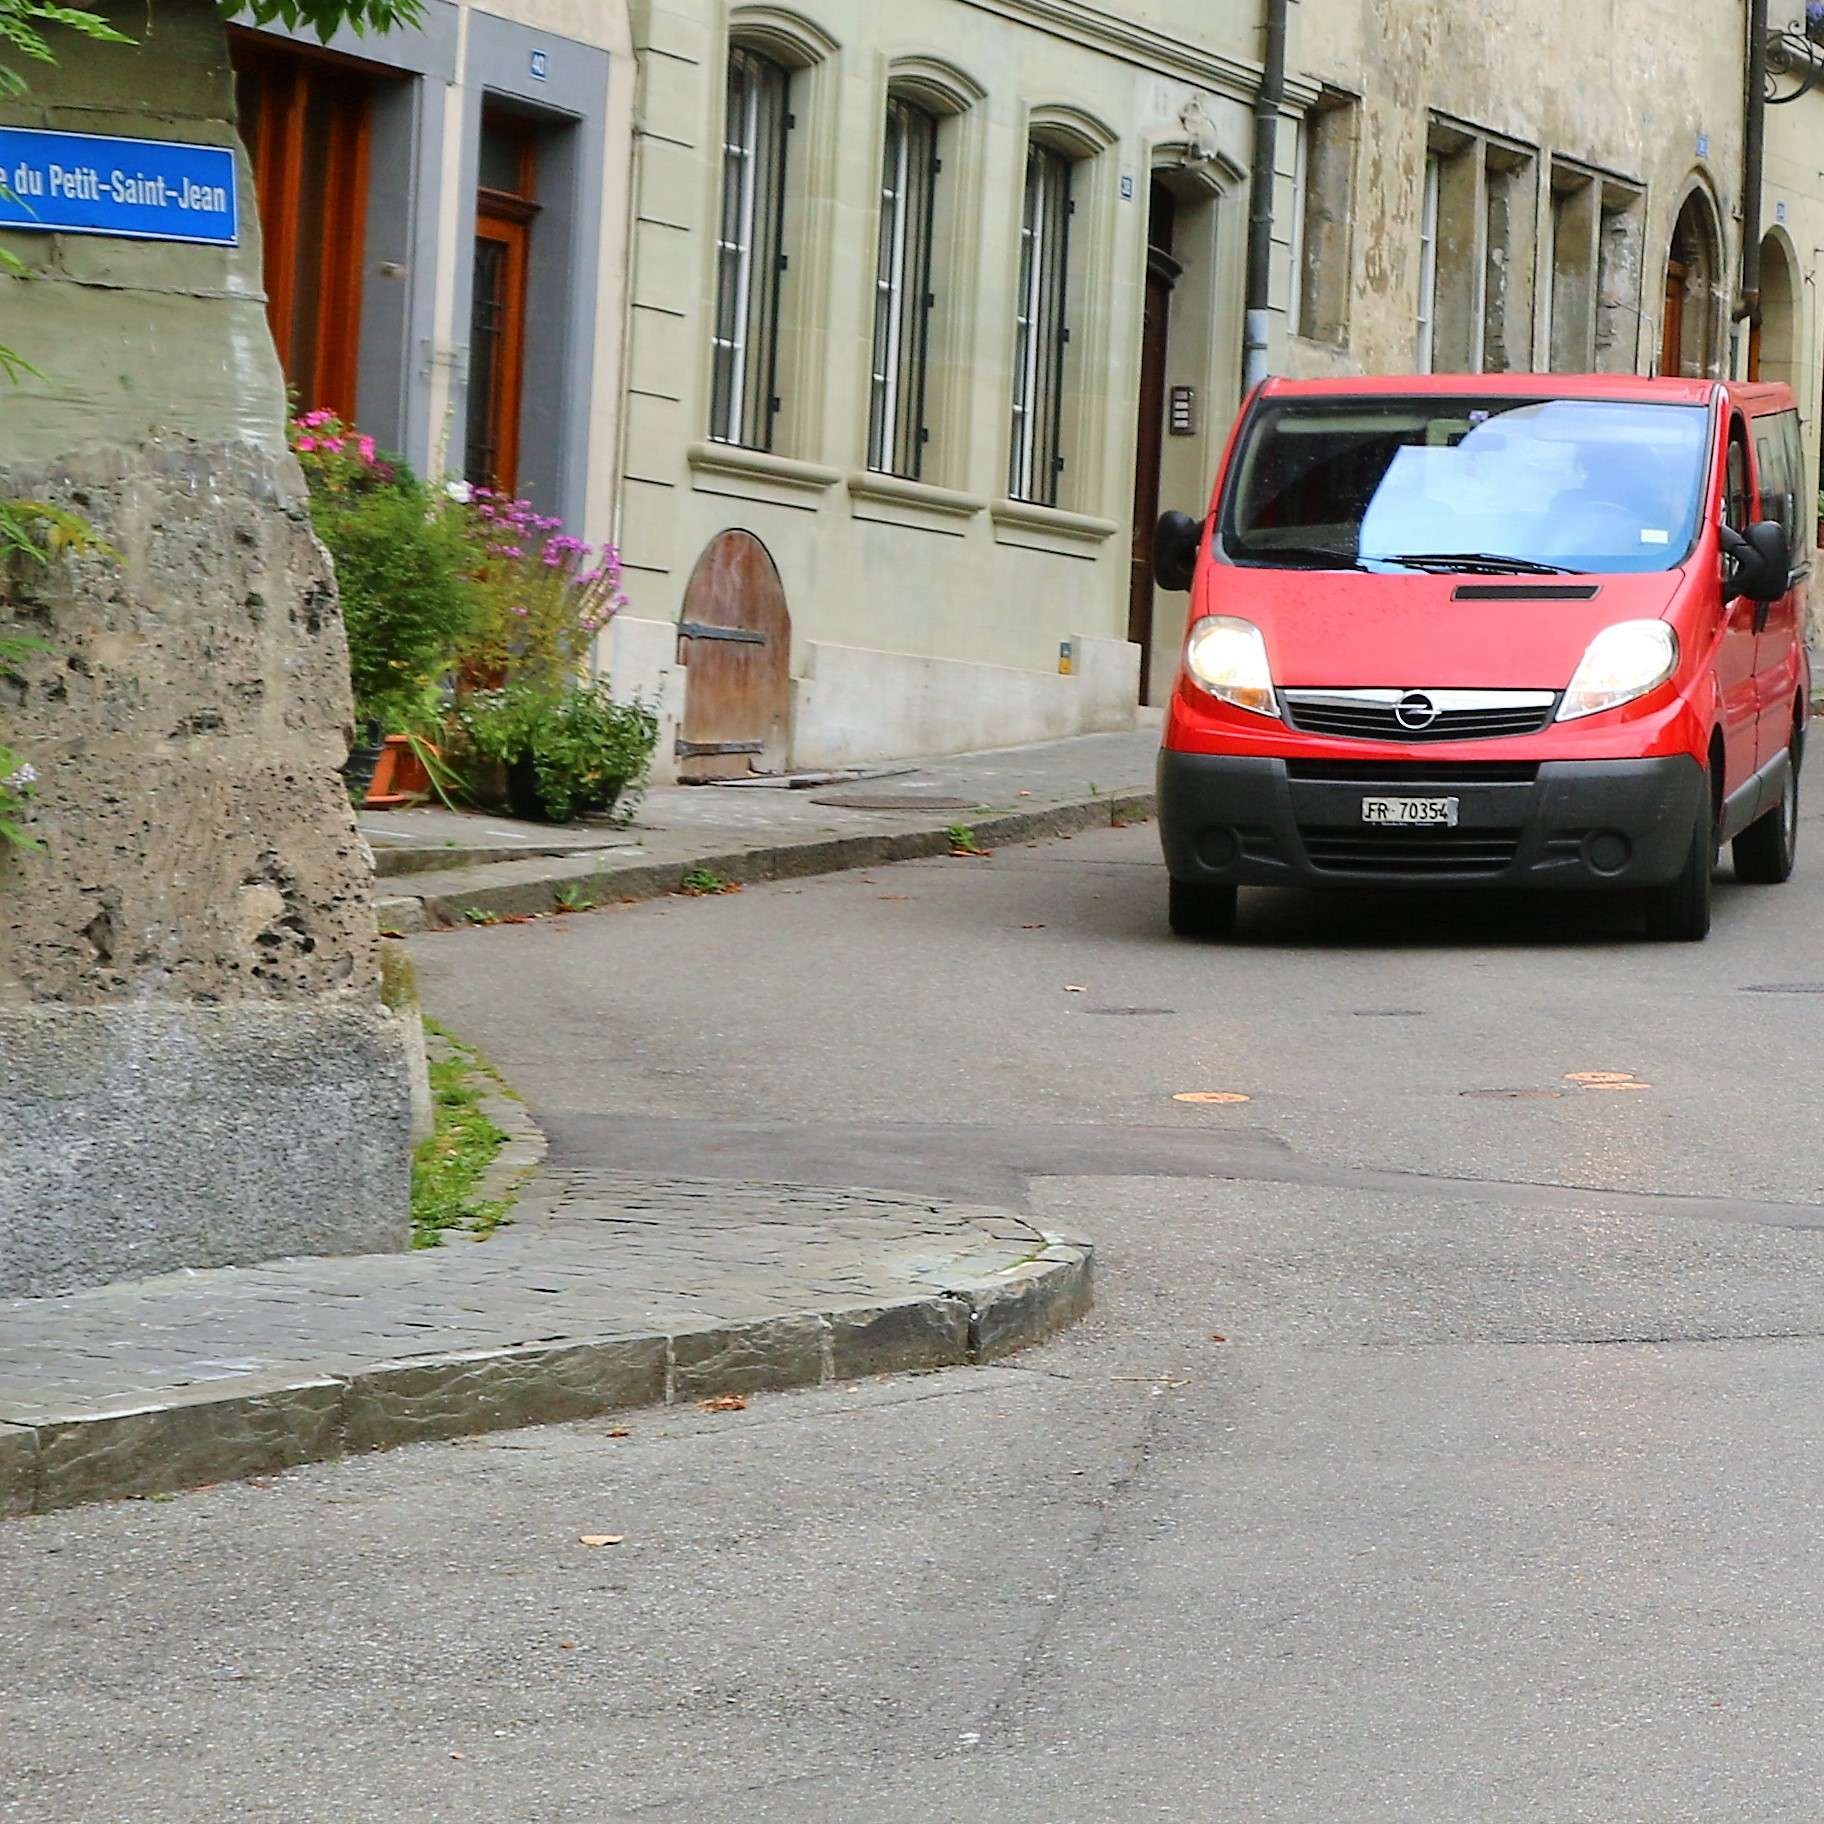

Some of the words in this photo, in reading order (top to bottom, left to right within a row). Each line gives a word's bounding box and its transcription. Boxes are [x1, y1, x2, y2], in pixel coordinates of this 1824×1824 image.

[15, 161, 44, 197] du
[49, 163, 227, 213] Petit-Saint-Jean
[1365, 803, 1388, 819] FR
[1400, 802, 1448, 820] 70354
